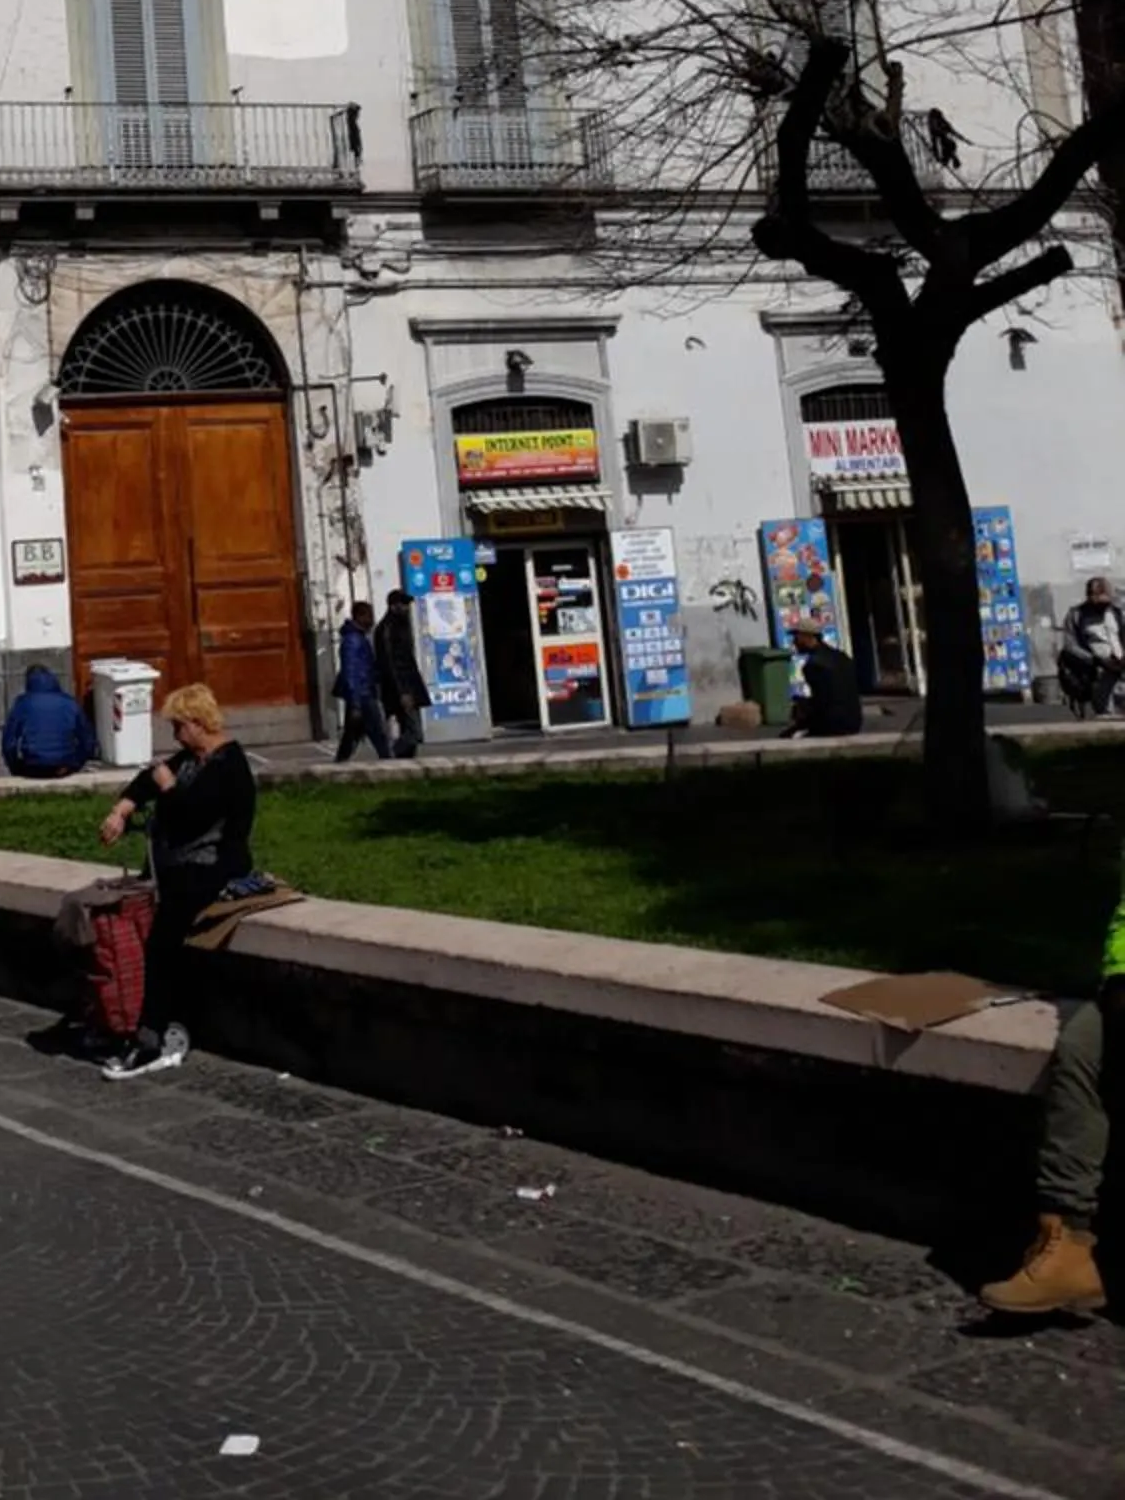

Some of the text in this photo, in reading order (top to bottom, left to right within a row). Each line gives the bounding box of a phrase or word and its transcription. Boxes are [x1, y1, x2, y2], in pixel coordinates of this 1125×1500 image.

[484, 433, 574, 453] INTERNET POINT
[809, 429, 840, 457] MINI
[621, 581, 675, 601] DIGI
[430, 689, 477, 705] DIGI
